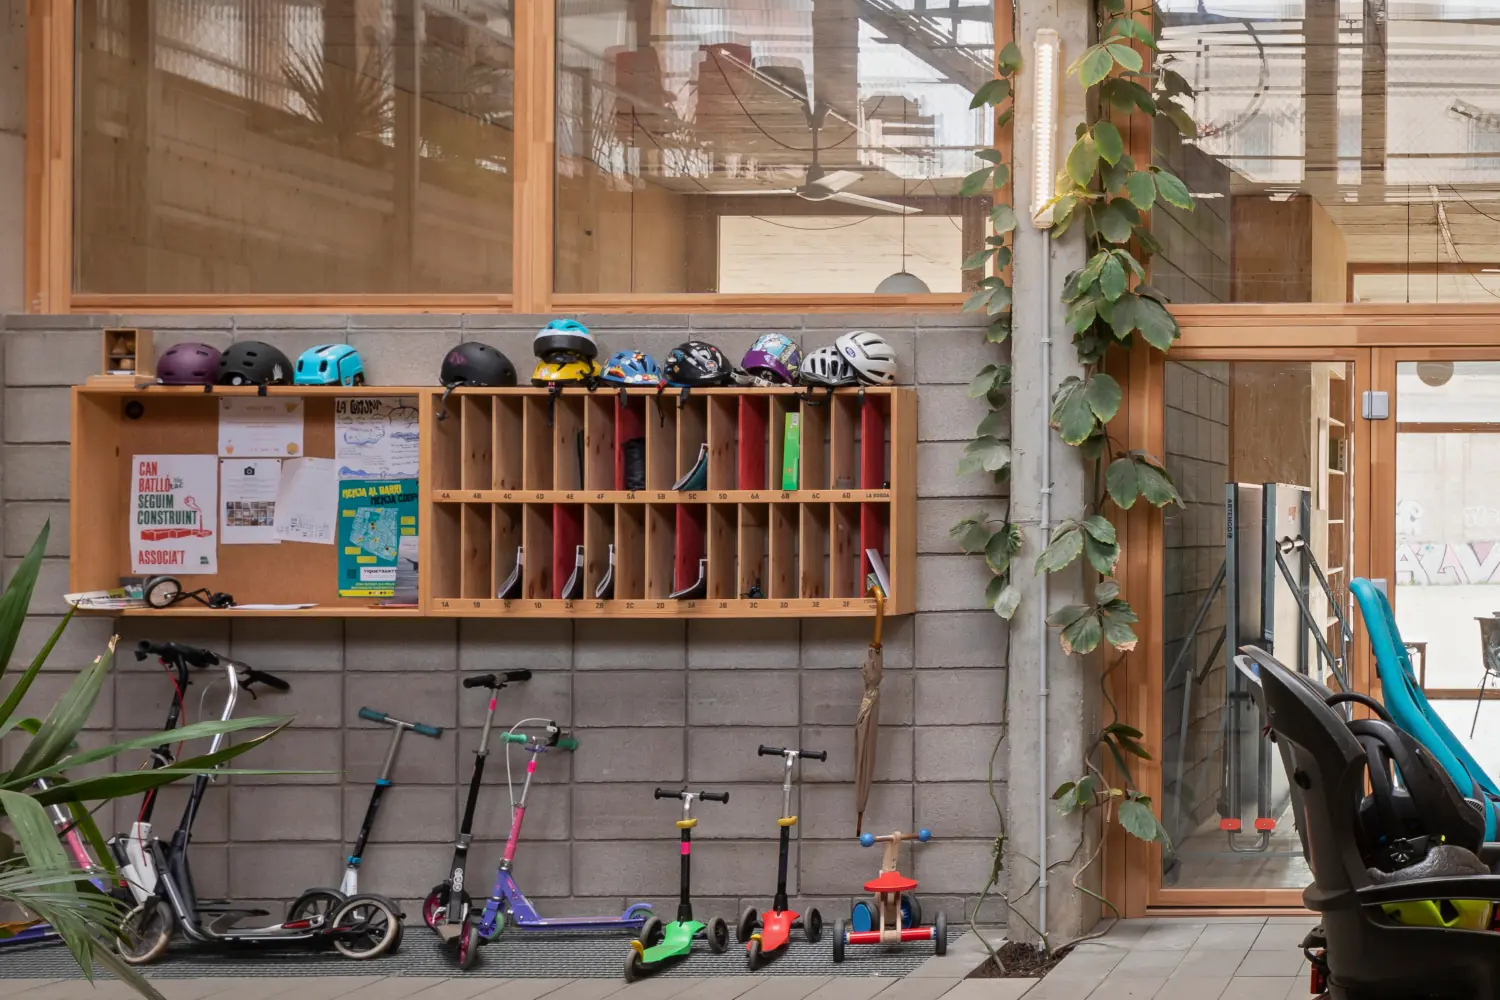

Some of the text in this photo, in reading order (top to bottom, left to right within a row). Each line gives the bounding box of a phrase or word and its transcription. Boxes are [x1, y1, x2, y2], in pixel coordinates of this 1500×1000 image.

[139, 461, 158, 477] CAN
[138, 474, 171, 492] BATLLÓ
[138, 494, 174, 509] SEGUIM
[137, 510, 198, 525] CONSTRUINT
[138, 550, 185, 565] ASSOCIA'T
